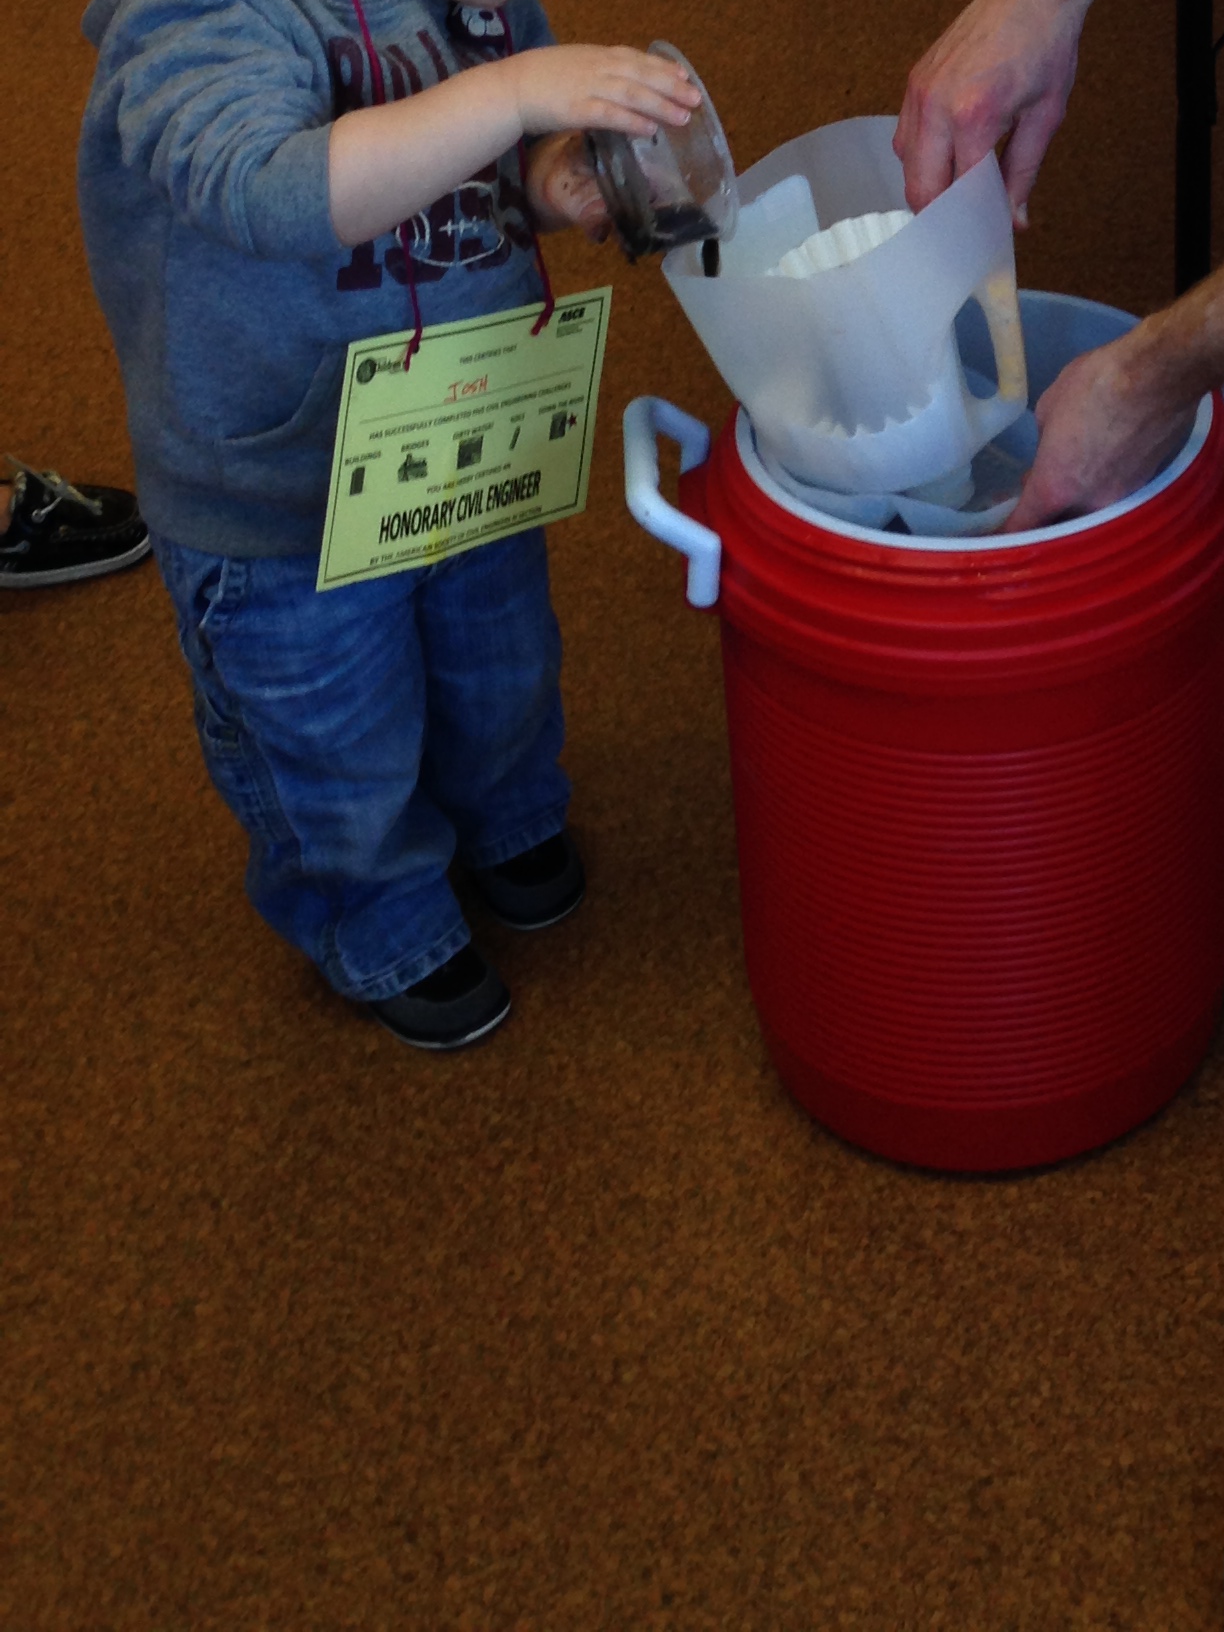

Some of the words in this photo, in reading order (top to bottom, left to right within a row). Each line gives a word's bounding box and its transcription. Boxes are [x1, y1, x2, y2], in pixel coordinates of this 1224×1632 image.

[443, 374, 488, 405] JOSH
[379, 498, 455, 545] HONORARY
[457, 488, 485, 521] CIVIL
[486, 471, 541, 510] ENGINEER
